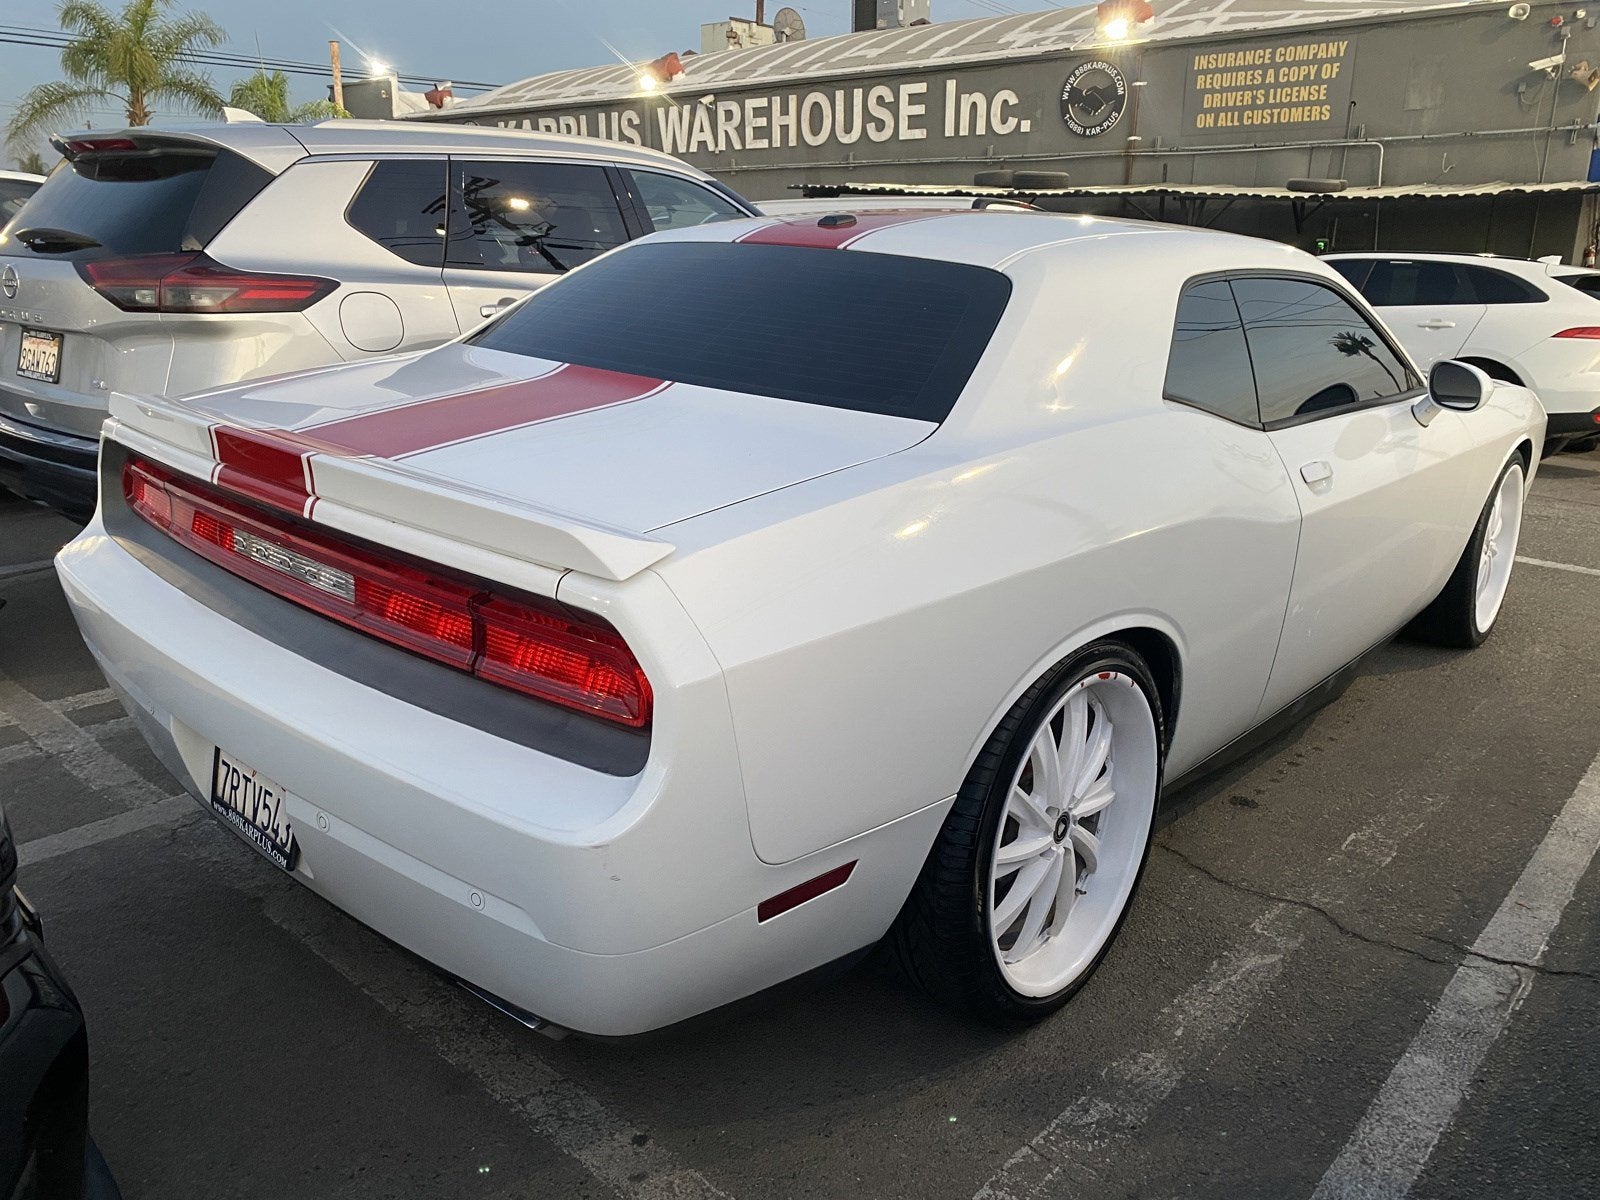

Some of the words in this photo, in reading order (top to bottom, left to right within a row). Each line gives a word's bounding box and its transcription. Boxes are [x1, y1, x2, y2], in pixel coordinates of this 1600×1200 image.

[1194, 48, 1272, 70] INSURANCE
[1275, 41, 1348, 62] COMPANY
[1196, 69, 1262, 89] REQUIRES
[1265, 69, 1275, 84] A
[1278, 64, 1318, 83] COPY
[1321, 62, 1341, 79] OF
[1203, 89, 1265, 108] DRIVER'S
[1268, 85, 1328, 104] LICENSE
[657, 82, 928, 154] WAREHOUSE
[944, 79, 1031, 137] Inc.
[1064, 113, 1084, 135] 1-(888)
[1086, 111, 1119, 136] KAR-PLUS
[1196, 113, 1214, 128] ON
[1217, 111, 1240, 127] ALL
[1243, 105, 1331, 125] CUSTOMERS
